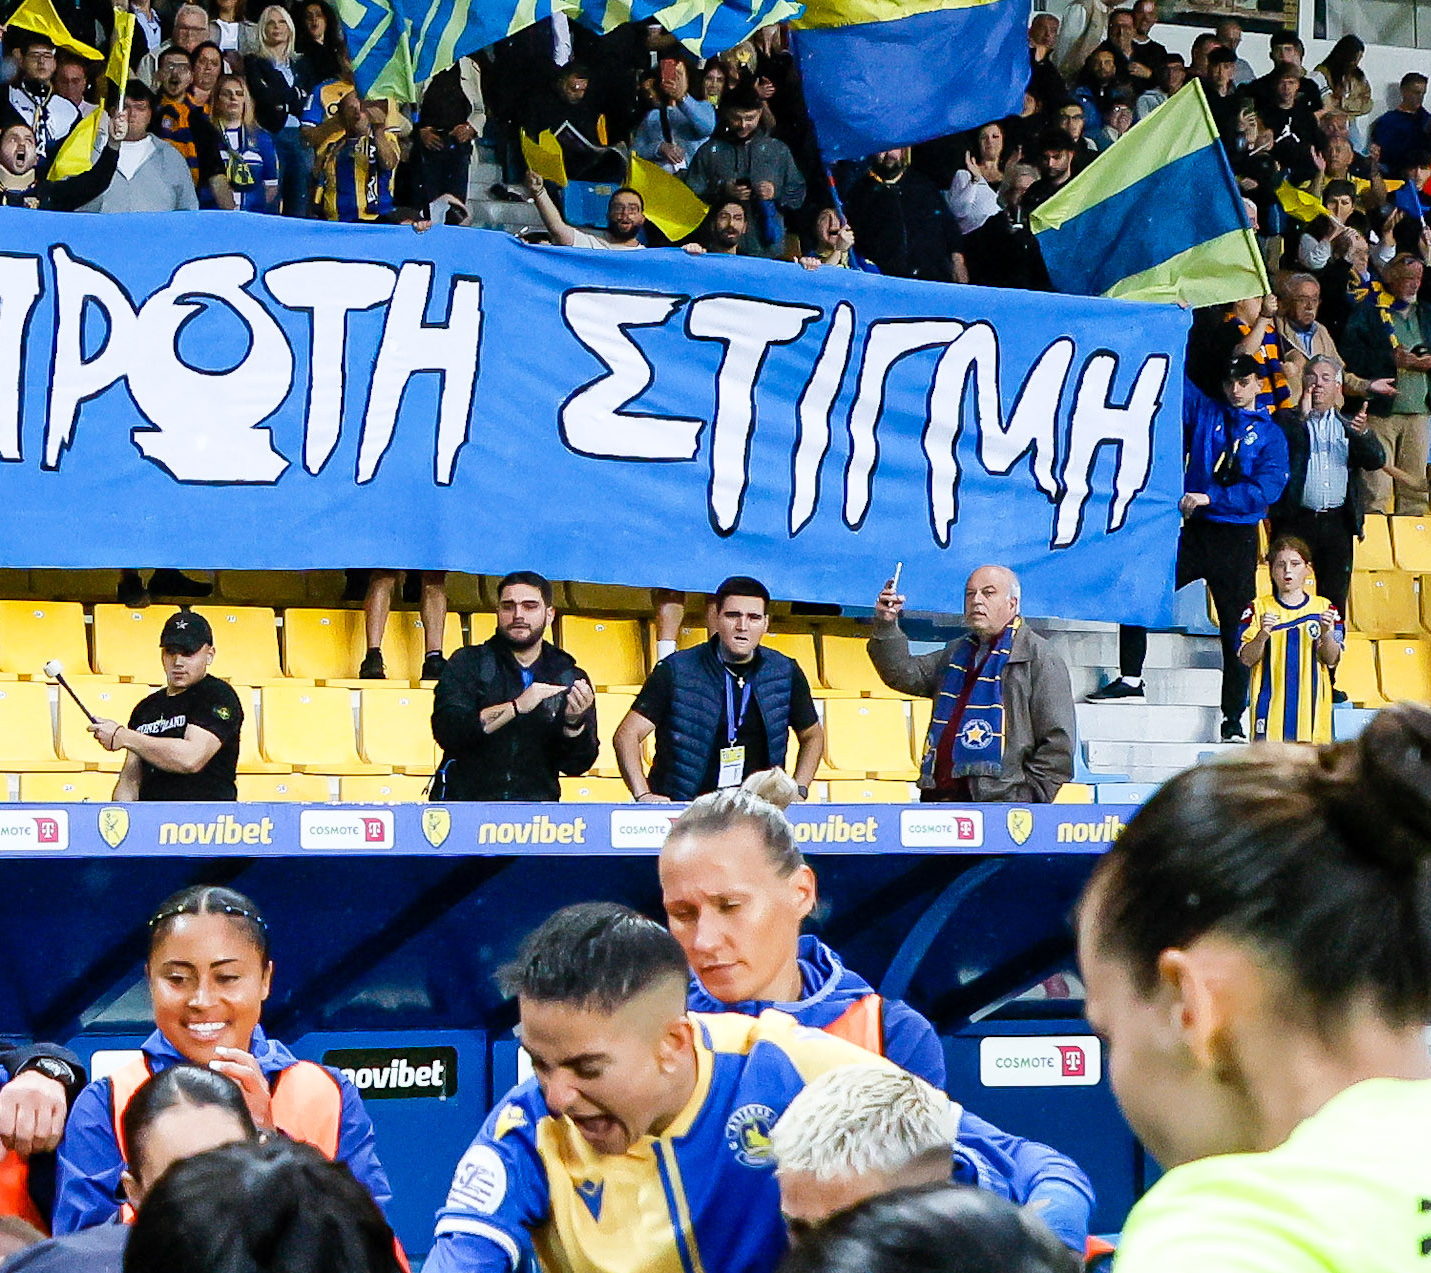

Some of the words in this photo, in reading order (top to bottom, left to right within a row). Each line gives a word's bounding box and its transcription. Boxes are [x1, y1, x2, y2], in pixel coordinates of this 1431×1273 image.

[556, 286, 1170, 549] ΣΤΙΓΜΗ
[158, 815, 275, 847] novibet
[309, 825, 360, 836] COSMOTE
[478, 815, 587, 846] novibet
[619, 825, 667, 835] COSMOTE
[792, 815, 878, 844] ovibet
[908, 824, 954, 835] COSMOTE
[995, 1056, 1056, 1070] COSMOTE
